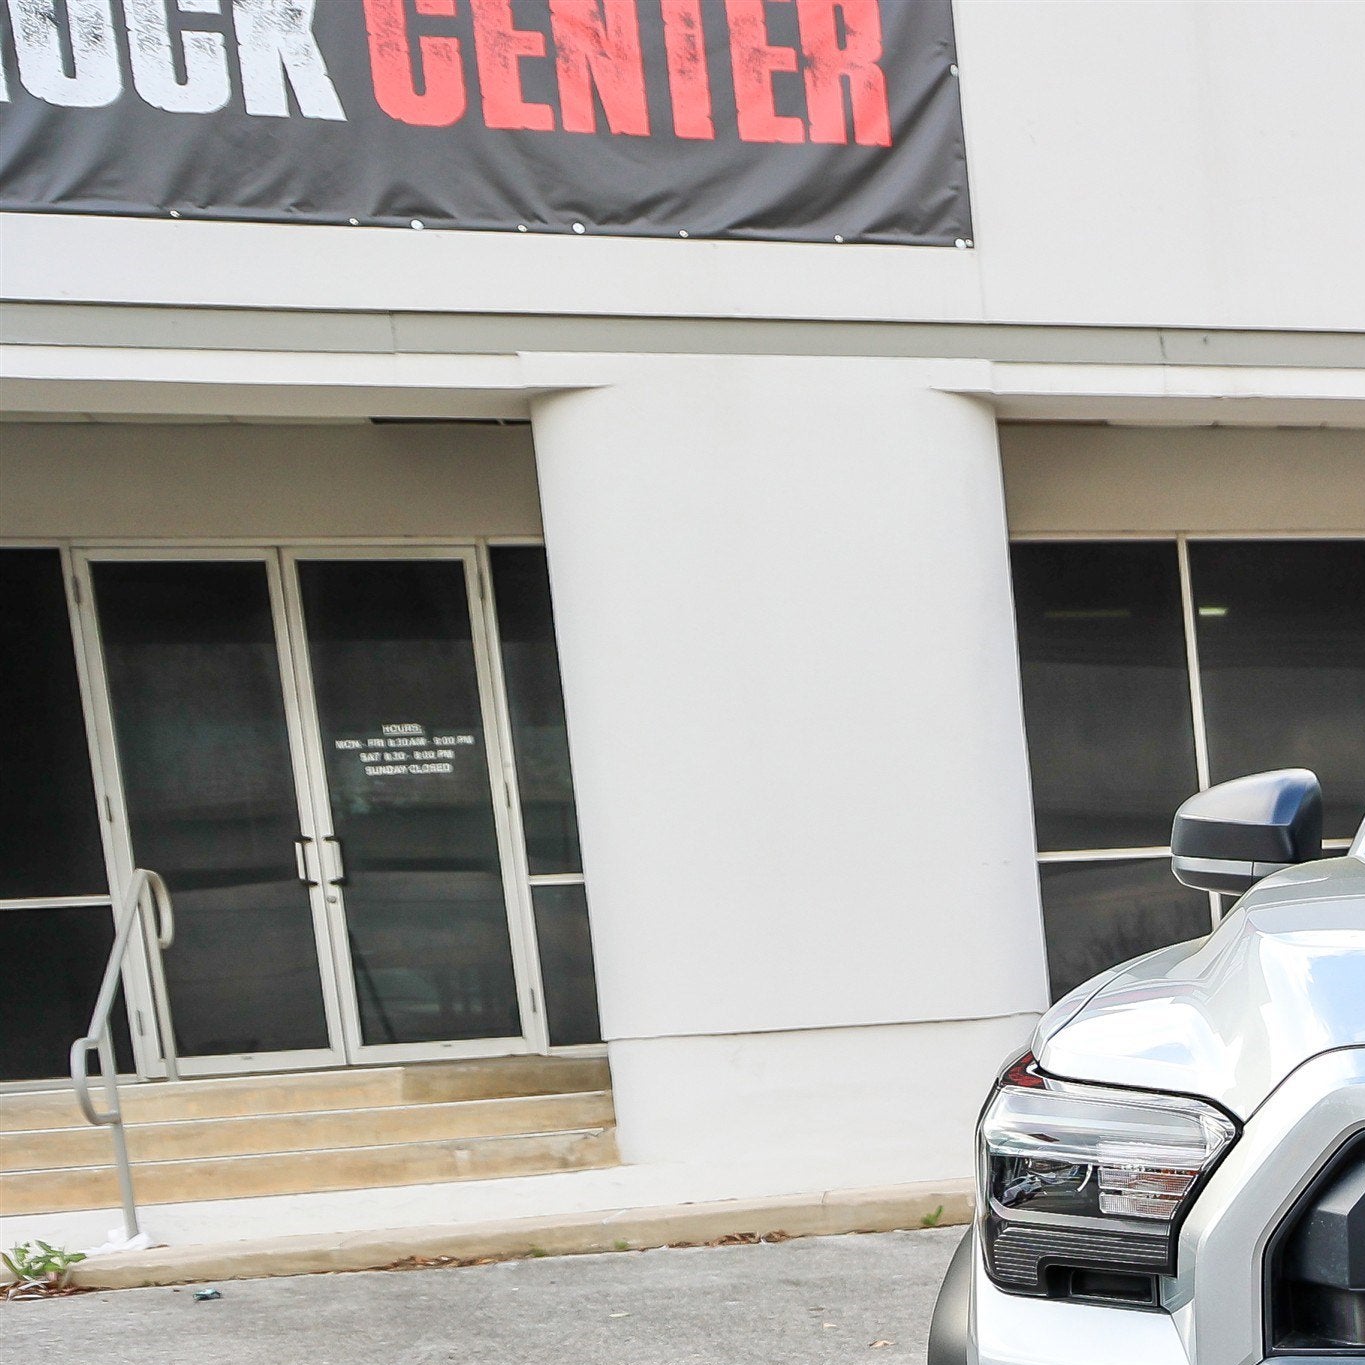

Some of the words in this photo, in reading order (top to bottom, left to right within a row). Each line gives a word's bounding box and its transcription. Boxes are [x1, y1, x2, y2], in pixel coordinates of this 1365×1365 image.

[363, 0, 893, 148] CENTER
[359, 752, 381, 762] SAT
[364, 764, 408, 776] SUNDAY
[408, 763, 454, 774] CLOSED
